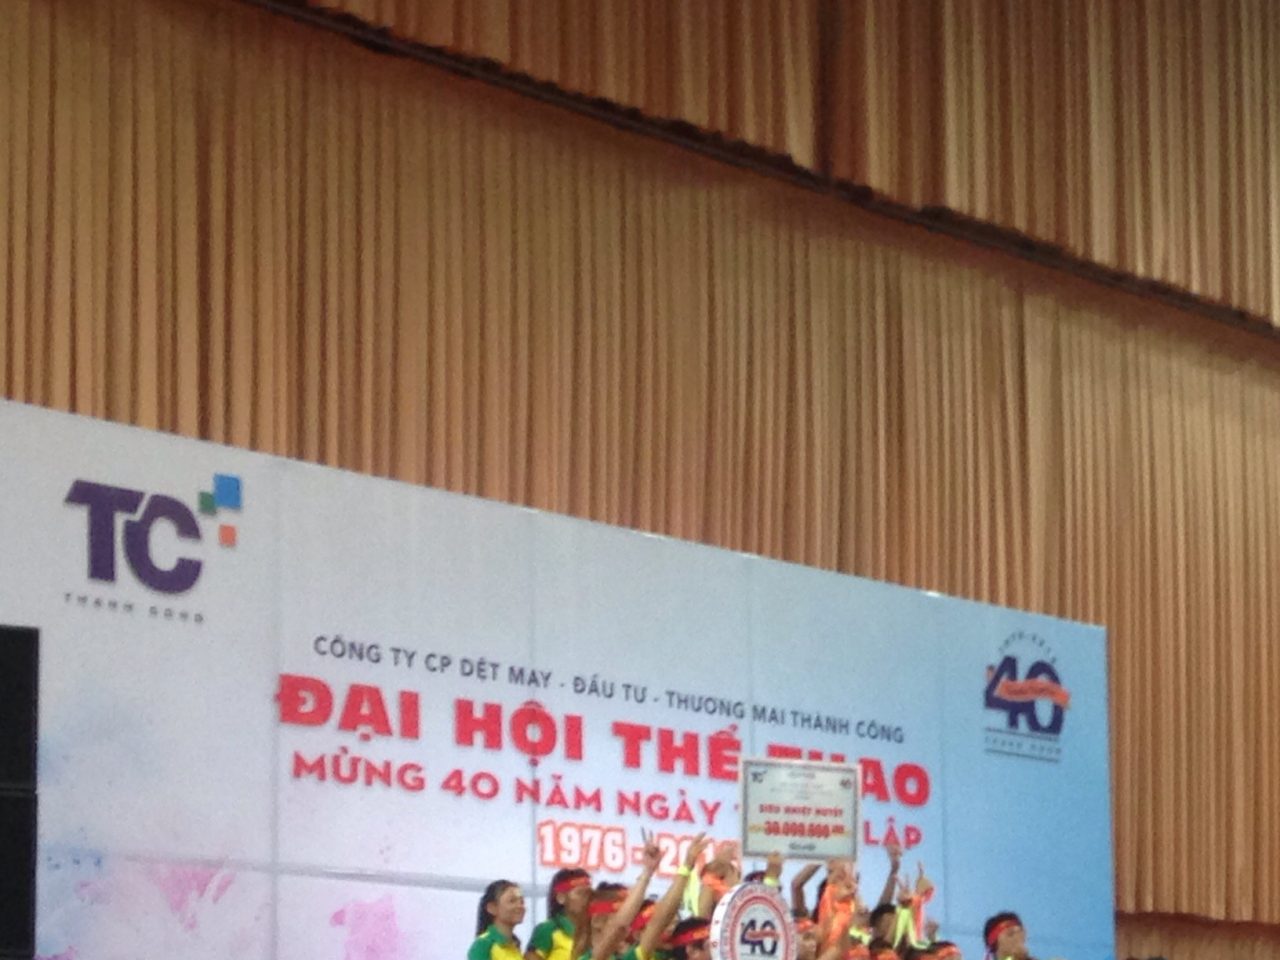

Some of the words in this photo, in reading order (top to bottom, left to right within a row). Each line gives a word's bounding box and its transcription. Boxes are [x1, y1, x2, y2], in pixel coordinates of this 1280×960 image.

[64, 479, 203, 594] TC
[274, 673, 420, 742] ĐẠI
[455, 697, 584, 767] HỘI
[612, 720, 742, 783] THỂ
[313, 634, 382, 664] CÔNG
[391, 646, 417, 669] TY
[424, 652, 452, 675] CP
[508, 665, 552, 689] MAY
[622, 683, 648, 704] TƯ
[790, 708, 850, 736] THÀNH
[855, 719, 905, 745] CÔNG
[984, 655, 1065, 736] 40
[292, 746, 426, 792] MỪNG
[441, 767, 500, 800] 40
[515, 773, 603, 814] NĂM
[617, 788, 722, 827] NGÀY
[538, 820, 627, 873] 1976
[739, 918, 778, 956] 40
